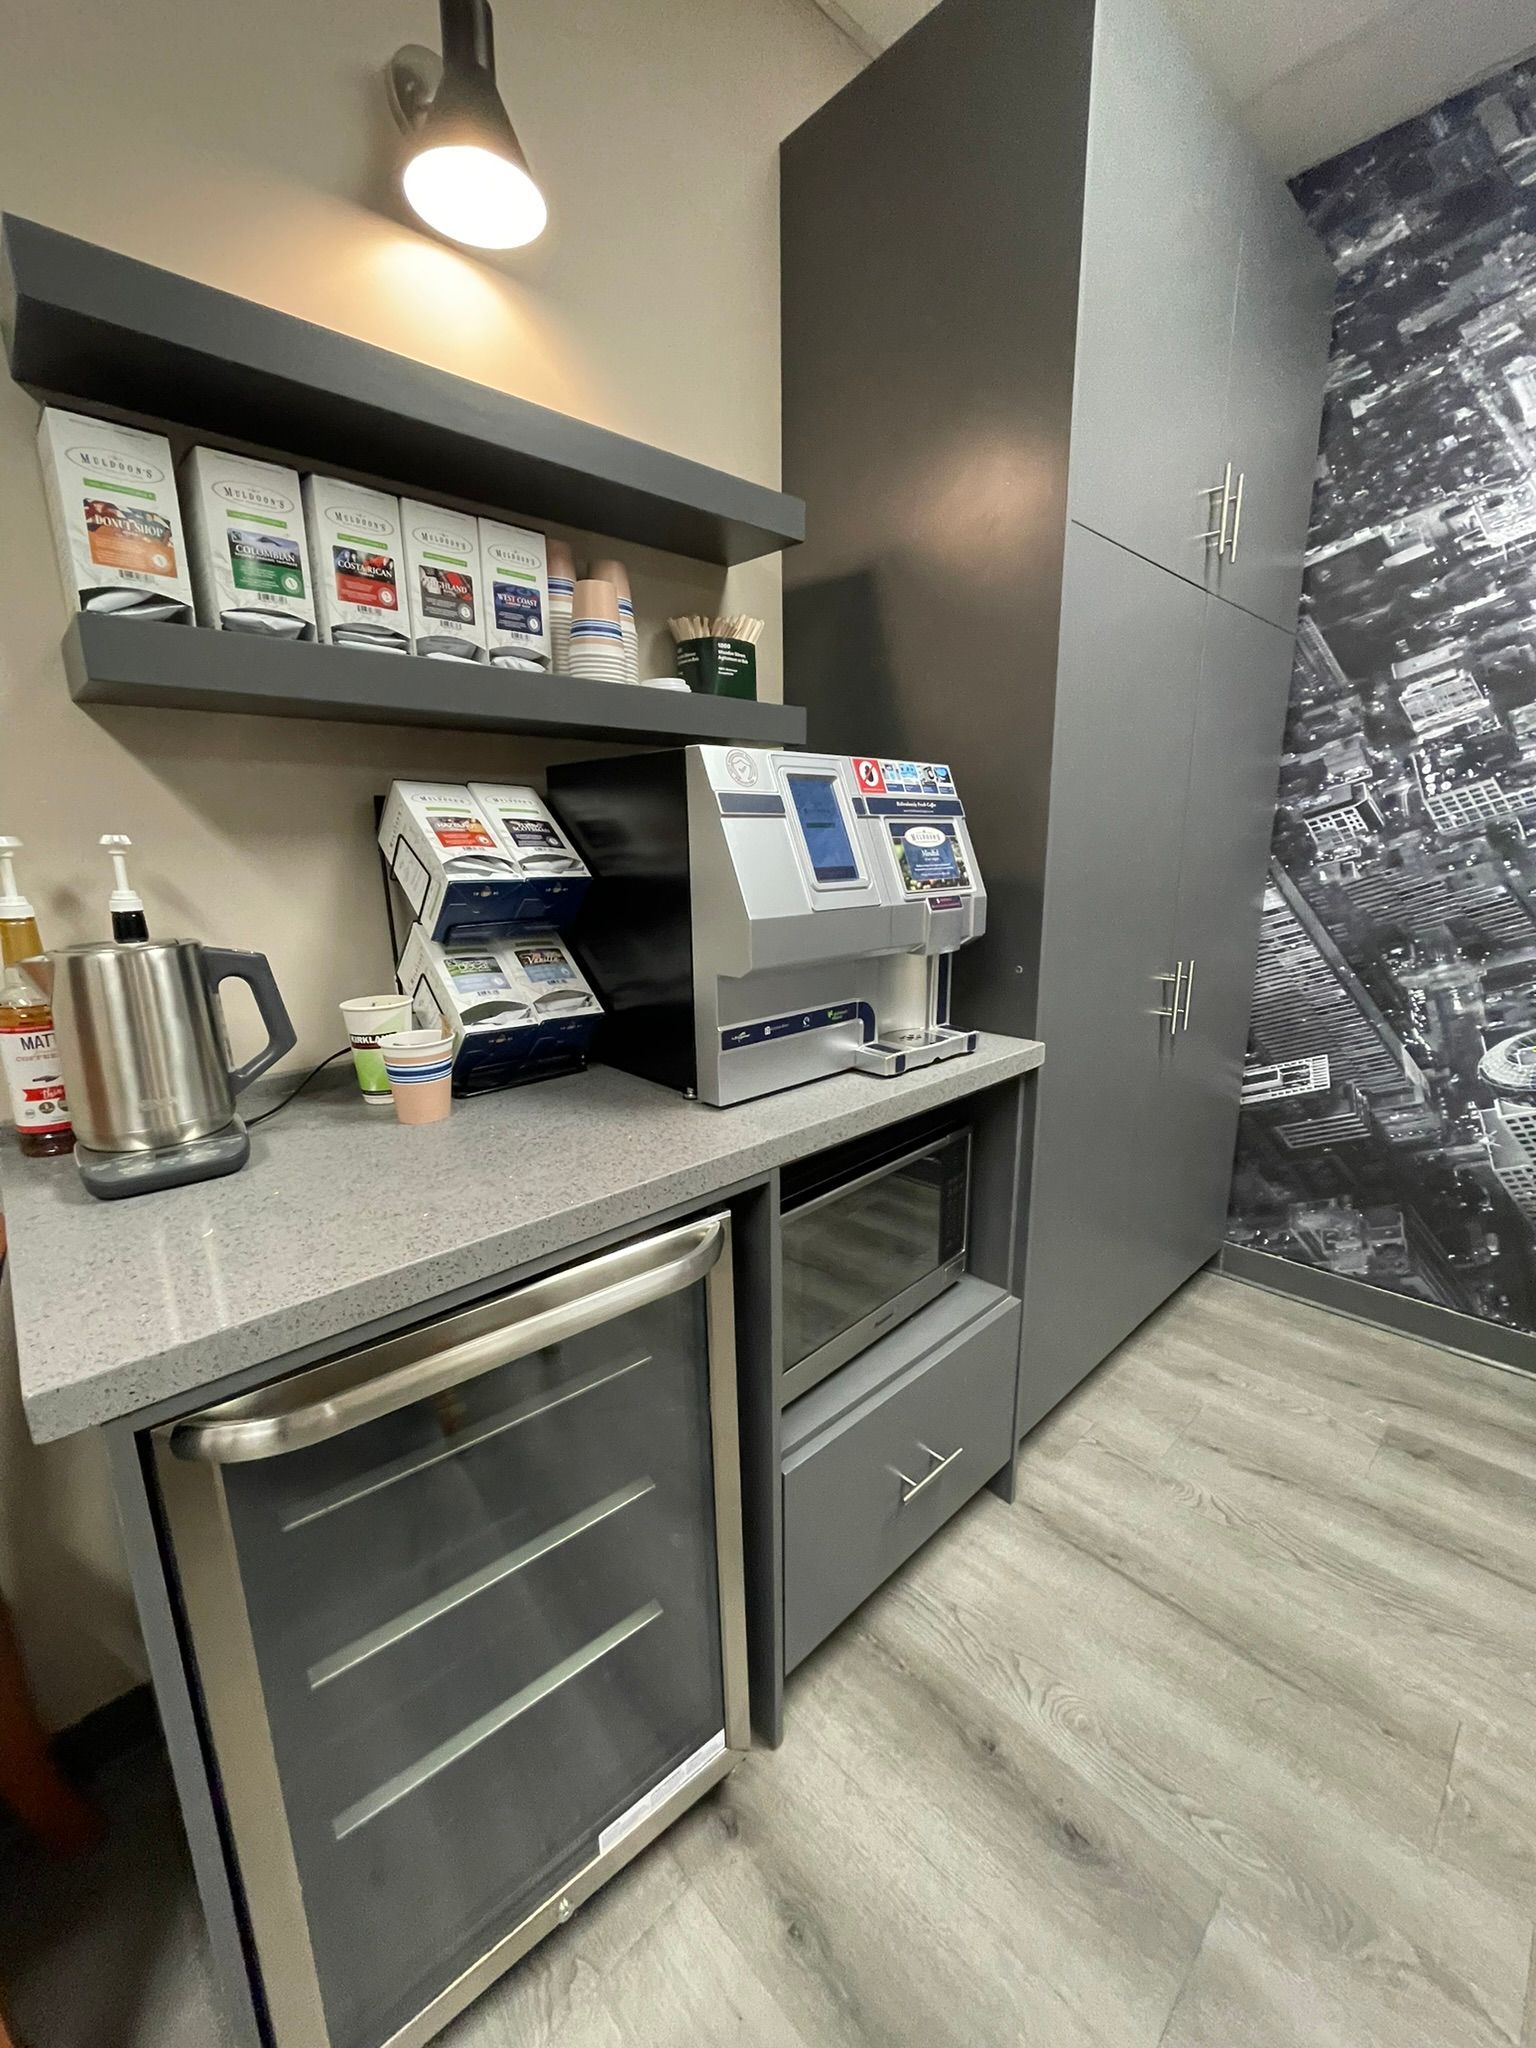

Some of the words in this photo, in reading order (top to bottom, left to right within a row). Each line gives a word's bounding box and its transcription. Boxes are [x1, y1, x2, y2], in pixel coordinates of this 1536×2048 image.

[80, 451, 154, 479] MULDOON'S
[223, 486, 285, 510] MULDOON'S
[94, 514, 134, 532] DONUT
[135, 519, 164, 537] SHOP
[235, 544, 295, 562] COLOMBIAN
[337, 560, 367, 573] COSTA
[367, 565, 392, 578] RICAN
[496, 592, 516, 602] WEST
[516, 596, 538, 607] COAST
